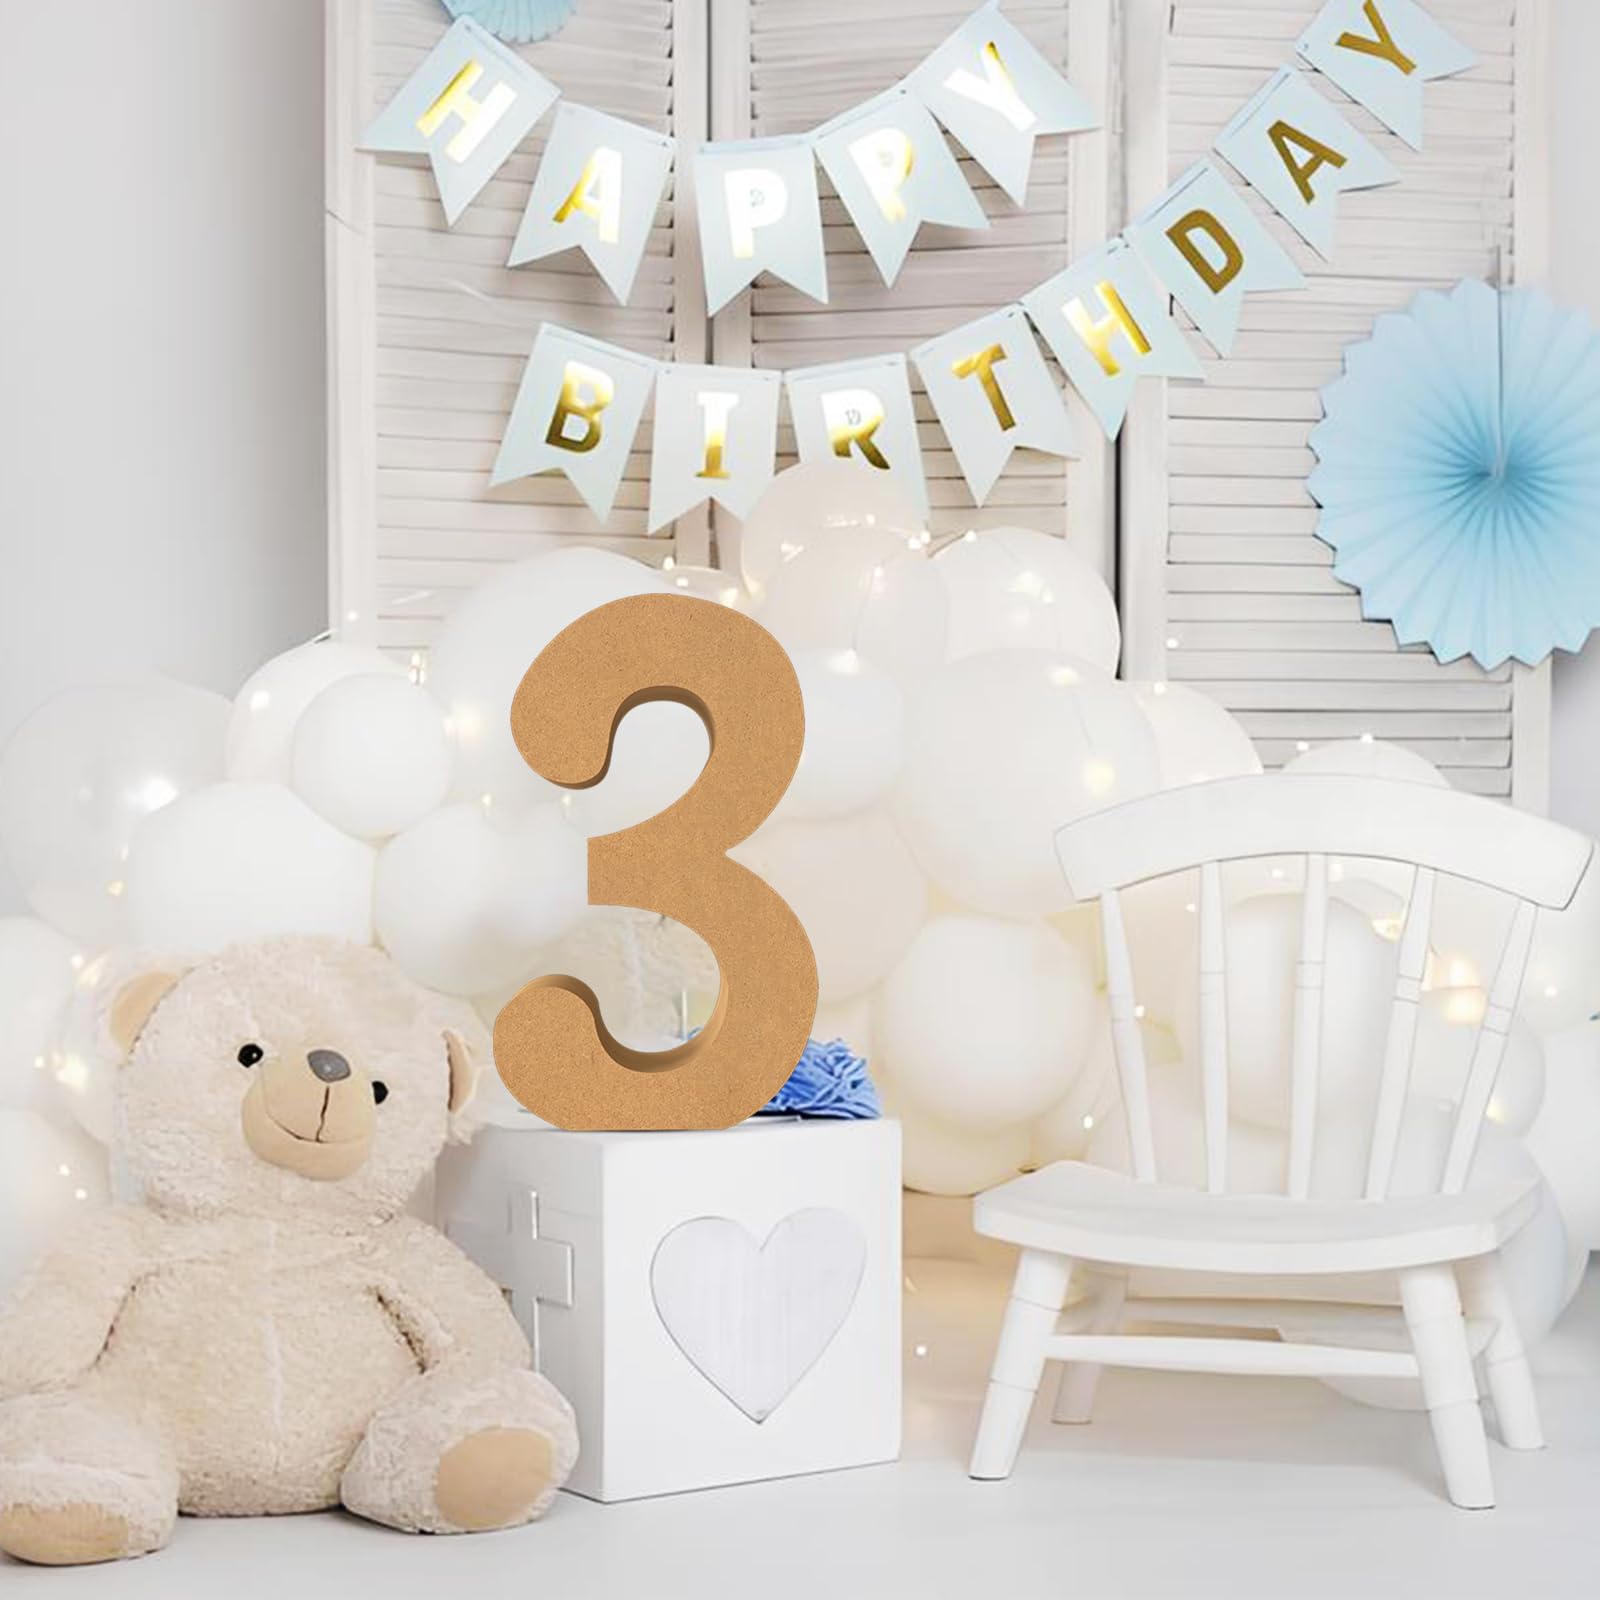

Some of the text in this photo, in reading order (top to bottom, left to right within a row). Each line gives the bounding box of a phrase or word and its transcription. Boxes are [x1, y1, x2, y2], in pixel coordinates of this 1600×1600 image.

[416, 41, 1038, 259] HAPPY
[545, 0, 1417, 479] BIRTHDAY
[493, 593, 819, 1132] 3
